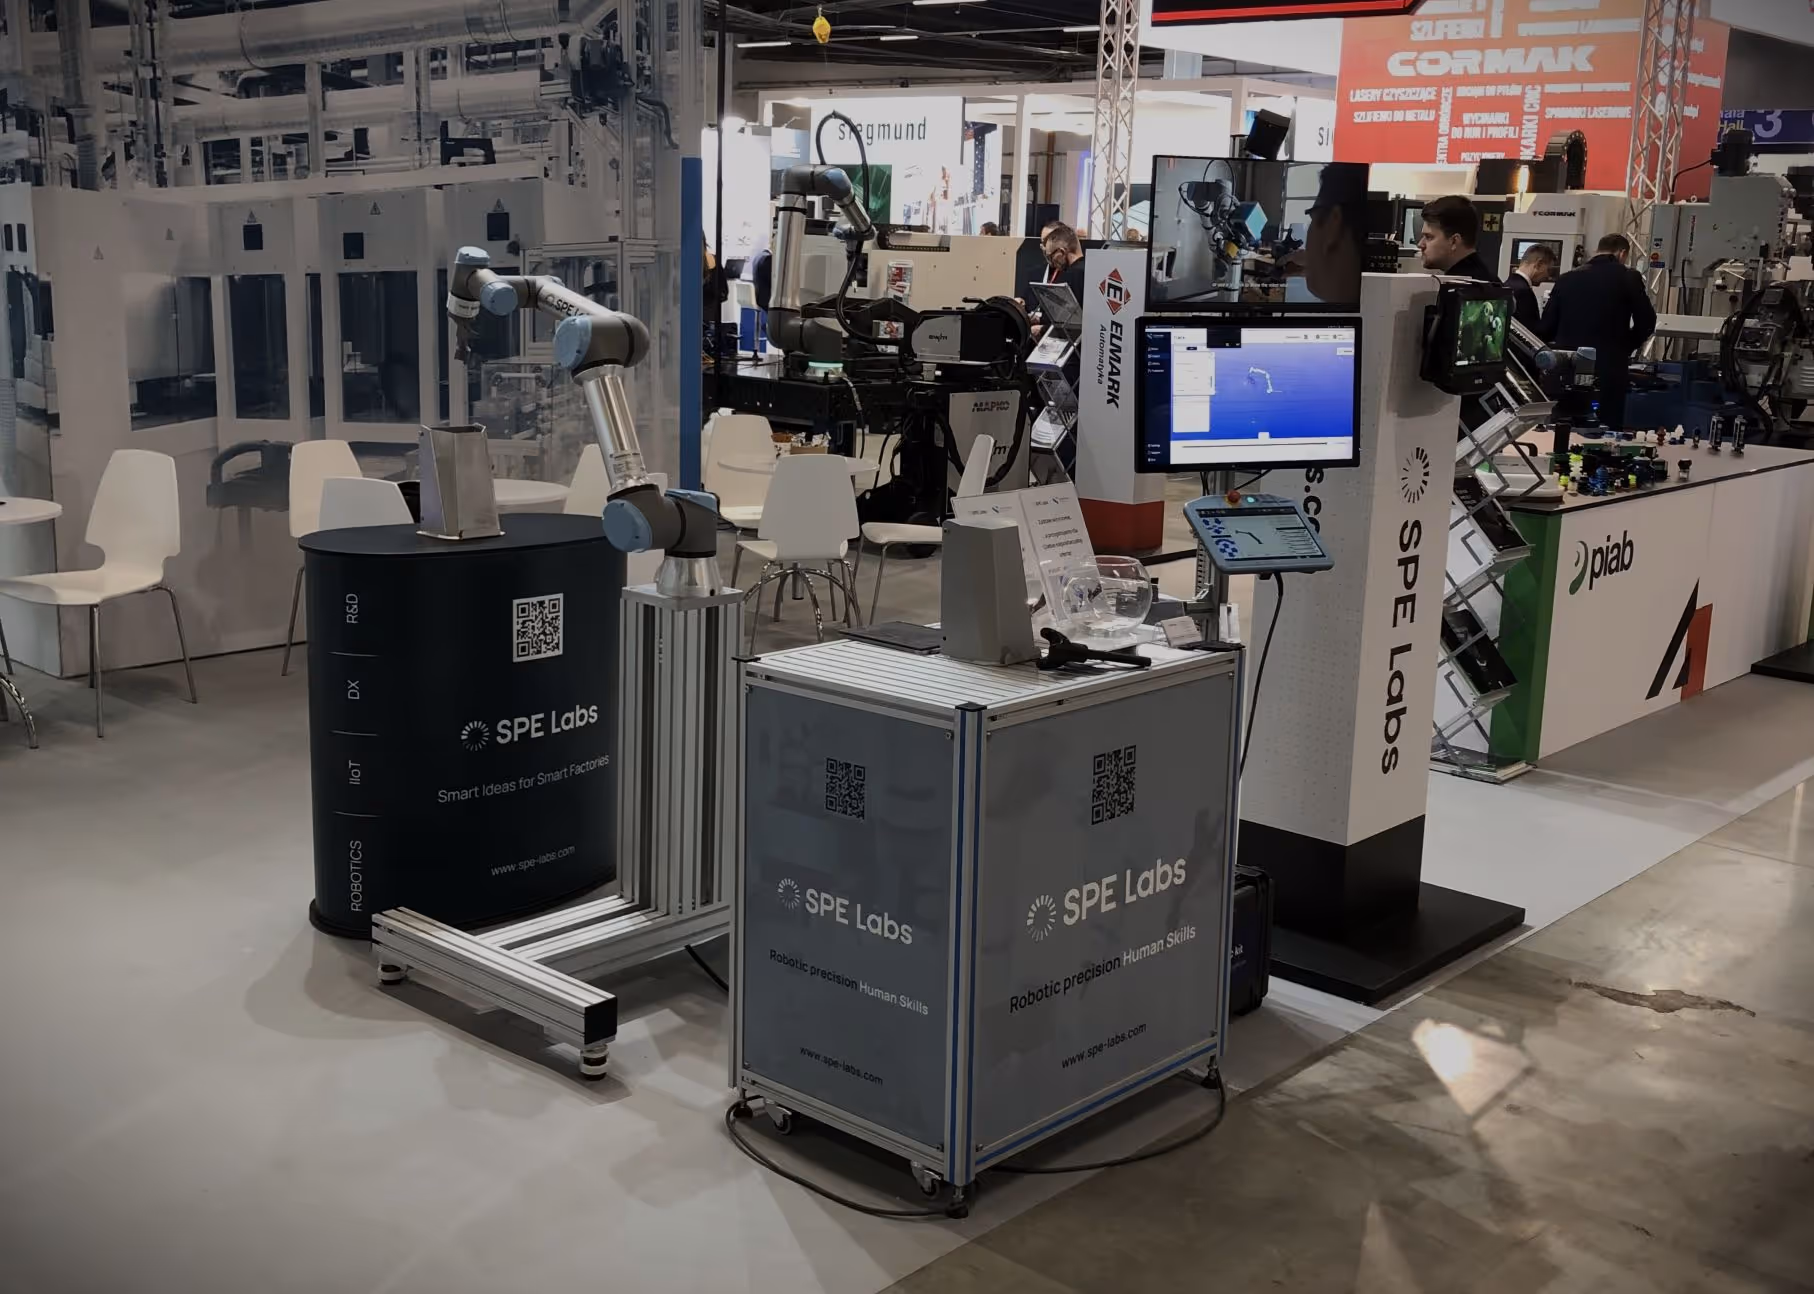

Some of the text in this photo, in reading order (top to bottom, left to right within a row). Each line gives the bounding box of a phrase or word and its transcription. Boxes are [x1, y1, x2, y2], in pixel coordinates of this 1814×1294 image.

[1387, 45, 1597, 77] CORMAK
[1523, 85, 1541, 112] CNC
[1754, 110, 1783, 138] 3
[554, 298, 575, 317] SPE
[1097, 324, 1107, 385] Automatyka
[1589, 530, 1634, 590] piab
[346, 593, 358, 624] R&D
[1381, 519, 1422, 775] SPE Labs
[347, 680, 360, 700] DX
[496, 704, 599, 744] SPE Labs
[438, 754, 610, 803] Smart Ideas for Smart Factories
[350, 840, 363, 912] ROBOTICS
[490, 845, 576, 876] www.spe-labs.com
[1063, 858, 1187, 926] SPE Labs
[805, 888, 913, 945] SPE Labs
[769, 949, 929, 1016] Robotic precision Human Skills
[1009, 924, 1197, 1014] Robotic precision Human Skills
[800, 1046, 884, 1086] www.spe-labs.com
[1061, 1022, 1147, 1070] www.spe-labs.com
